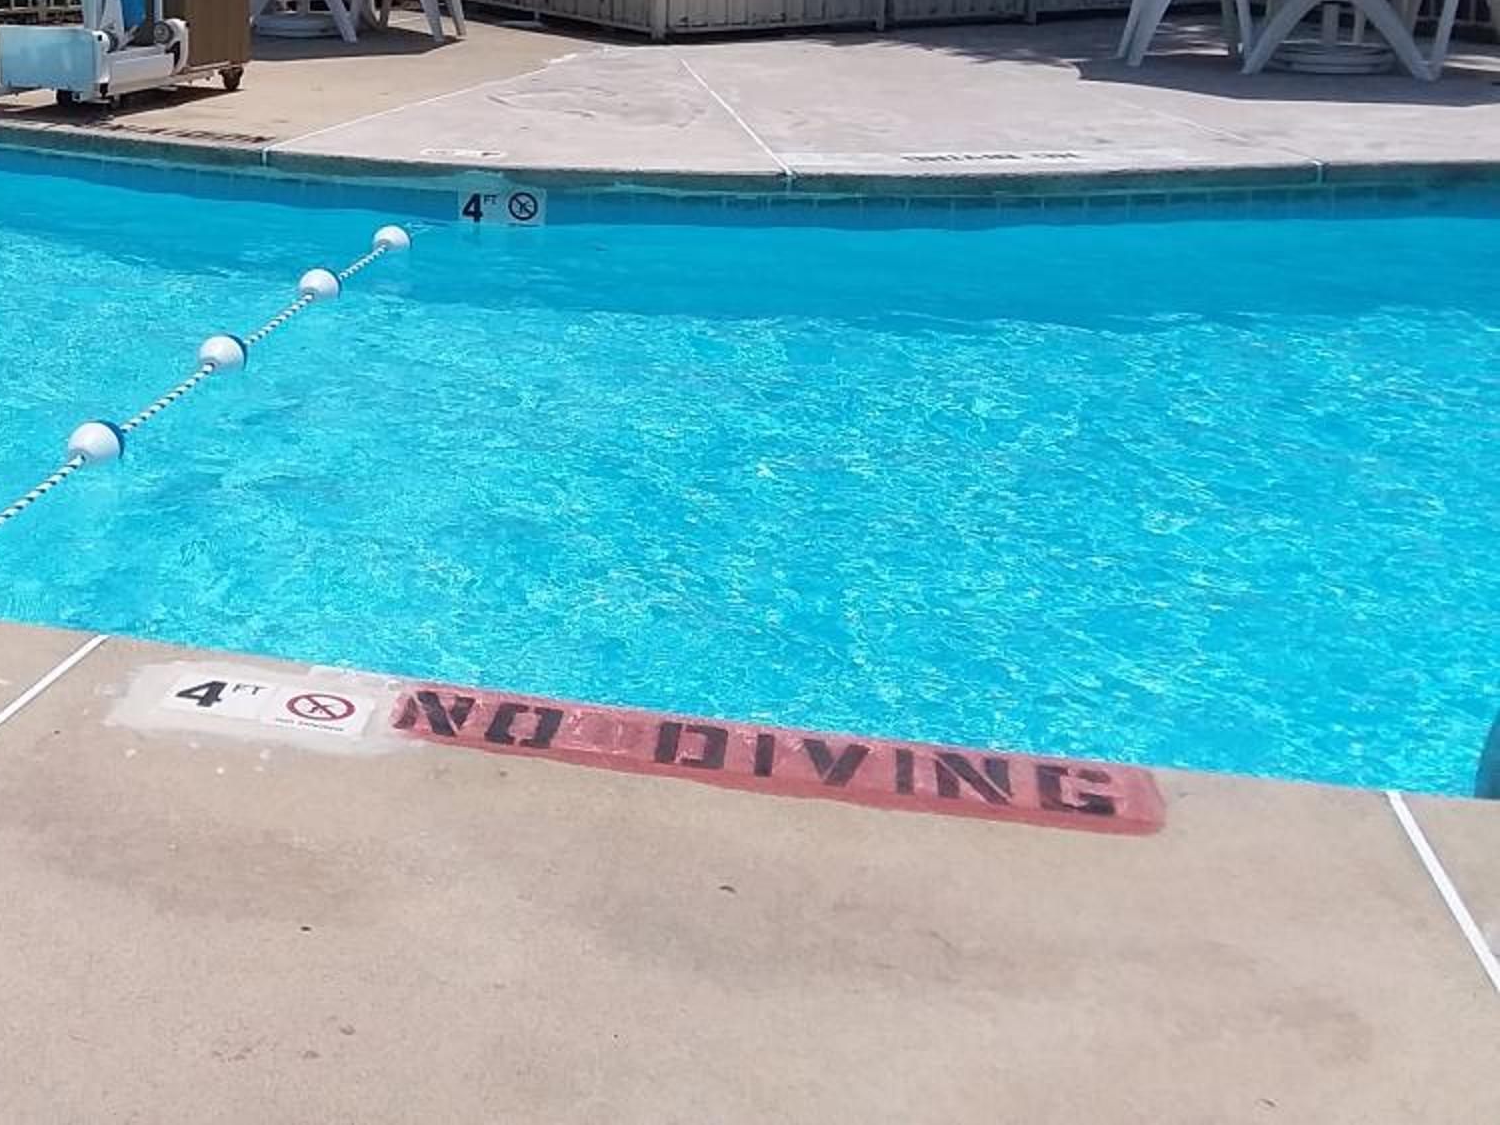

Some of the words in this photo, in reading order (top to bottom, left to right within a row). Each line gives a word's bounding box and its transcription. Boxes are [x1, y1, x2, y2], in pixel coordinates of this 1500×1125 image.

[462, 193, 483, 223] 4
[175, 680, 228, 707] 4
[231, 683, 267, 695] FT
[392, 691, 564, 748] NO
[654, 721, 1116, 816] DIVING
